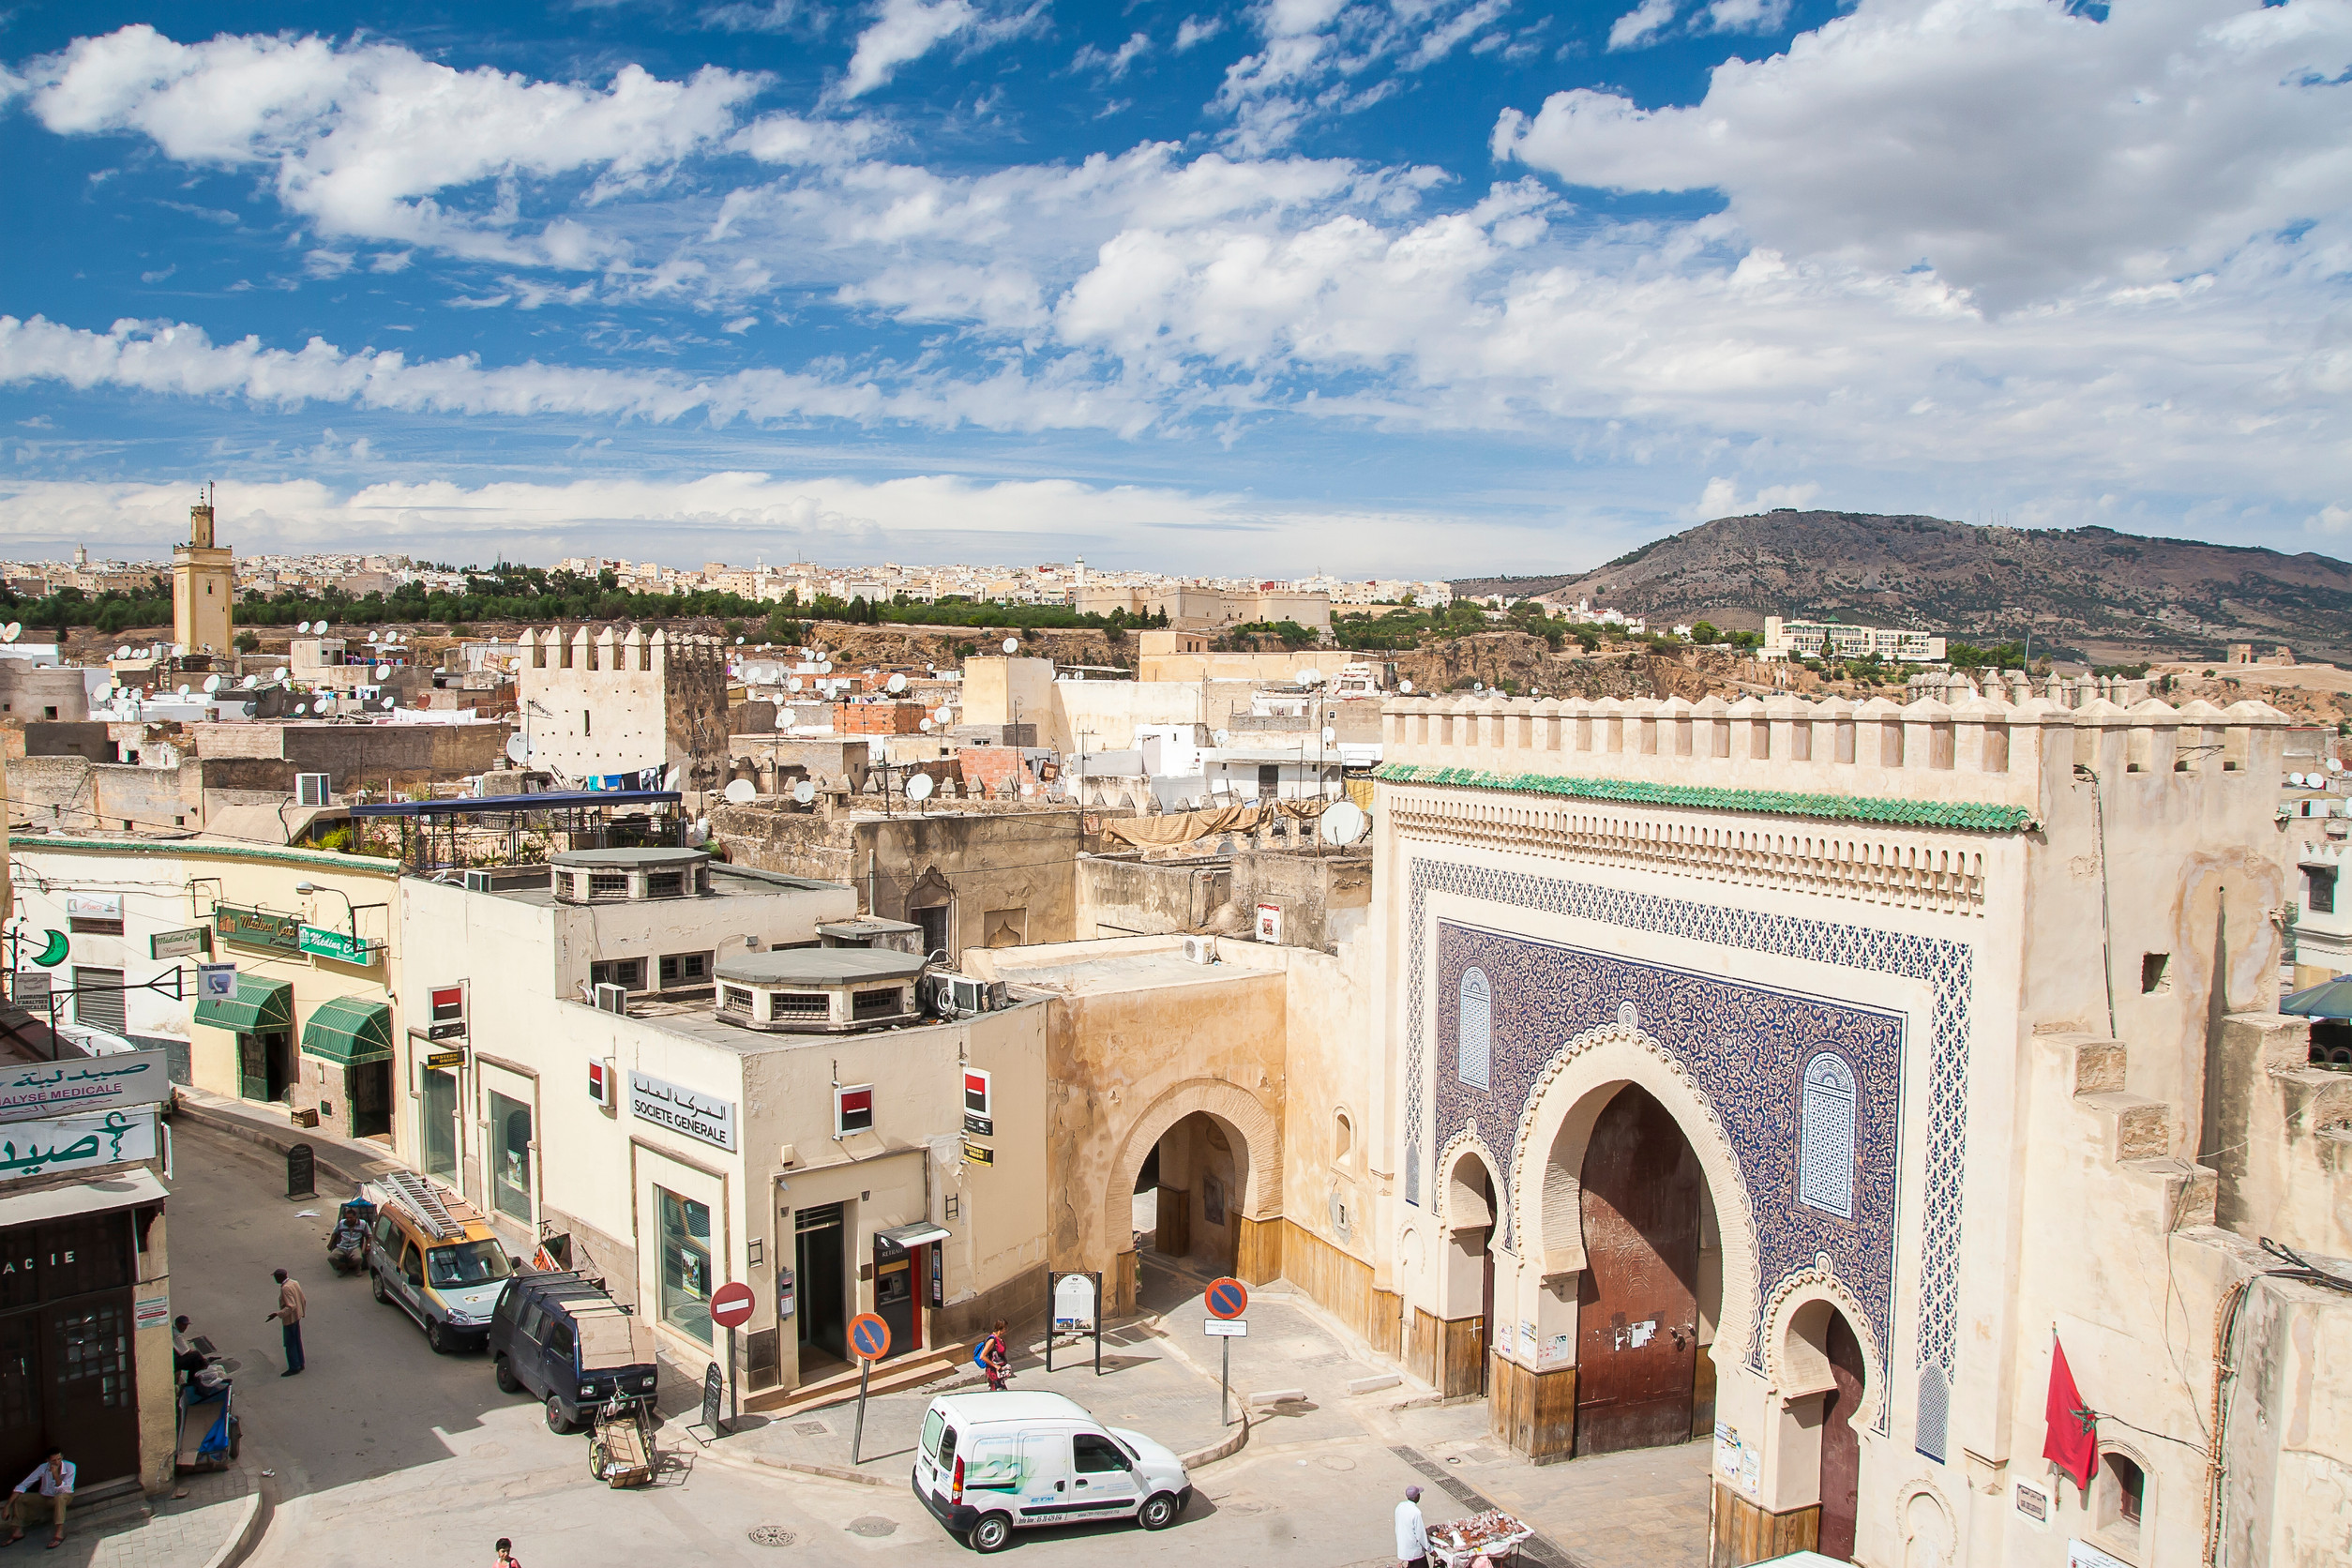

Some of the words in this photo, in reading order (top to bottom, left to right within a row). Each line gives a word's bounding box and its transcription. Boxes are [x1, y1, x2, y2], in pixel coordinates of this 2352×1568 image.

[0, 1092, 47, 1107] ALYSE
[51, 1082, 123, 1099] MEDICALE
[634, 1078, 672, 1102] العامة
[674, 1092, 726, 1121] الشركة
[634, 1098, 673, 1124] SOCIETE
[674, 1113, 727, 1144] GENERALE
